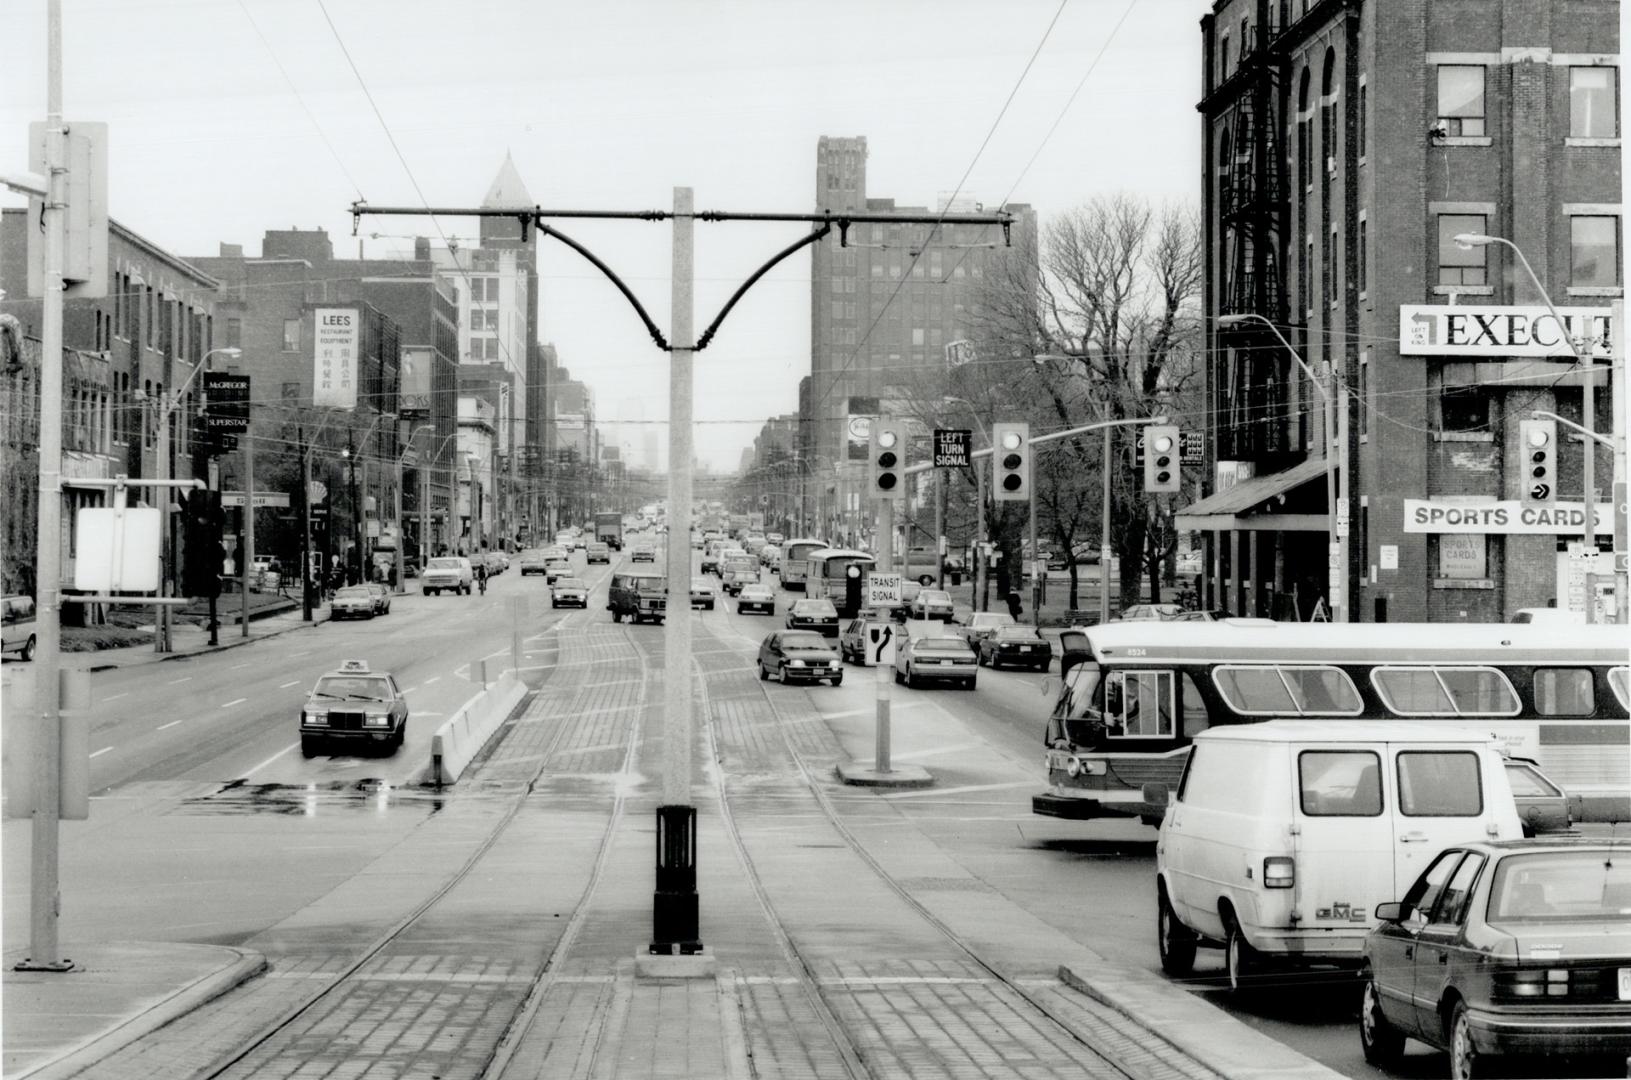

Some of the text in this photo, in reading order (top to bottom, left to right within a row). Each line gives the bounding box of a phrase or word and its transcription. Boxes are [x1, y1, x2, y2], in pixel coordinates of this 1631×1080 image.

[323, 315, 351, 326] LEES
[209, 419, 247, 427] SUPERSTAR
[940, 432, 964, 443] LEFT
[940, 443, 965, 455] TURN
[936, 454, 969, 466] SIGNAL
[1415, 507, 1509, 525] SPORTS
[1521, 508, 1600, 526] CARDS
[1446, 550, 1477, 560] CARDS
[870, 577, 900, 587] TRANSIT
[872, 591, 898, 601] SIGNAL
[1315, 907, 1366, 920] GMC
